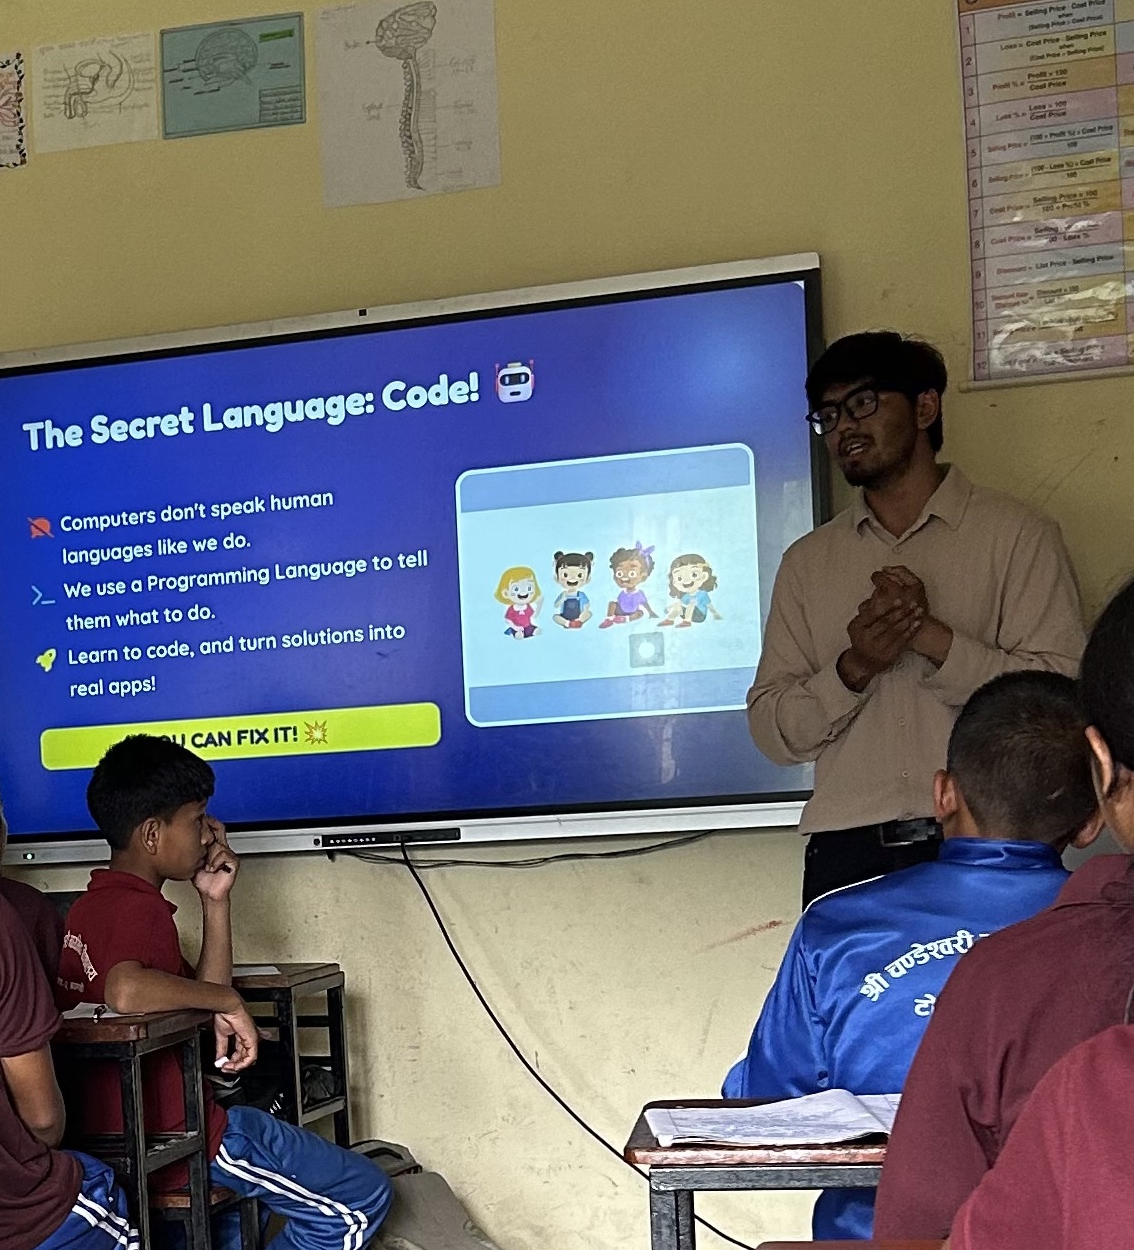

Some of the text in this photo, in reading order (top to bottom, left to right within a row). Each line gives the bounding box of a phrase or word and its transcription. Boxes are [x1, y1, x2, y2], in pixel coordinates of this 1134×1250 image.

[22, 371, 479, 450] The Secret Language: Code!
[60, 492, 334, 532] Computers don't speak human
[62, 532, 251, 565] languages like we do.
[63, 549, 428, 599] We use a Programming Language to tell
[66, 603, 216, 630] them what to do.
[68, 624, 406, 664] Learn to code, and turn solutions into
[70, 675, 156, 697] real apps!
[191, 730, 232, 748] CAN
[237, 727, 269, 746] FIX
[274, 725, 298, 743] IT!
